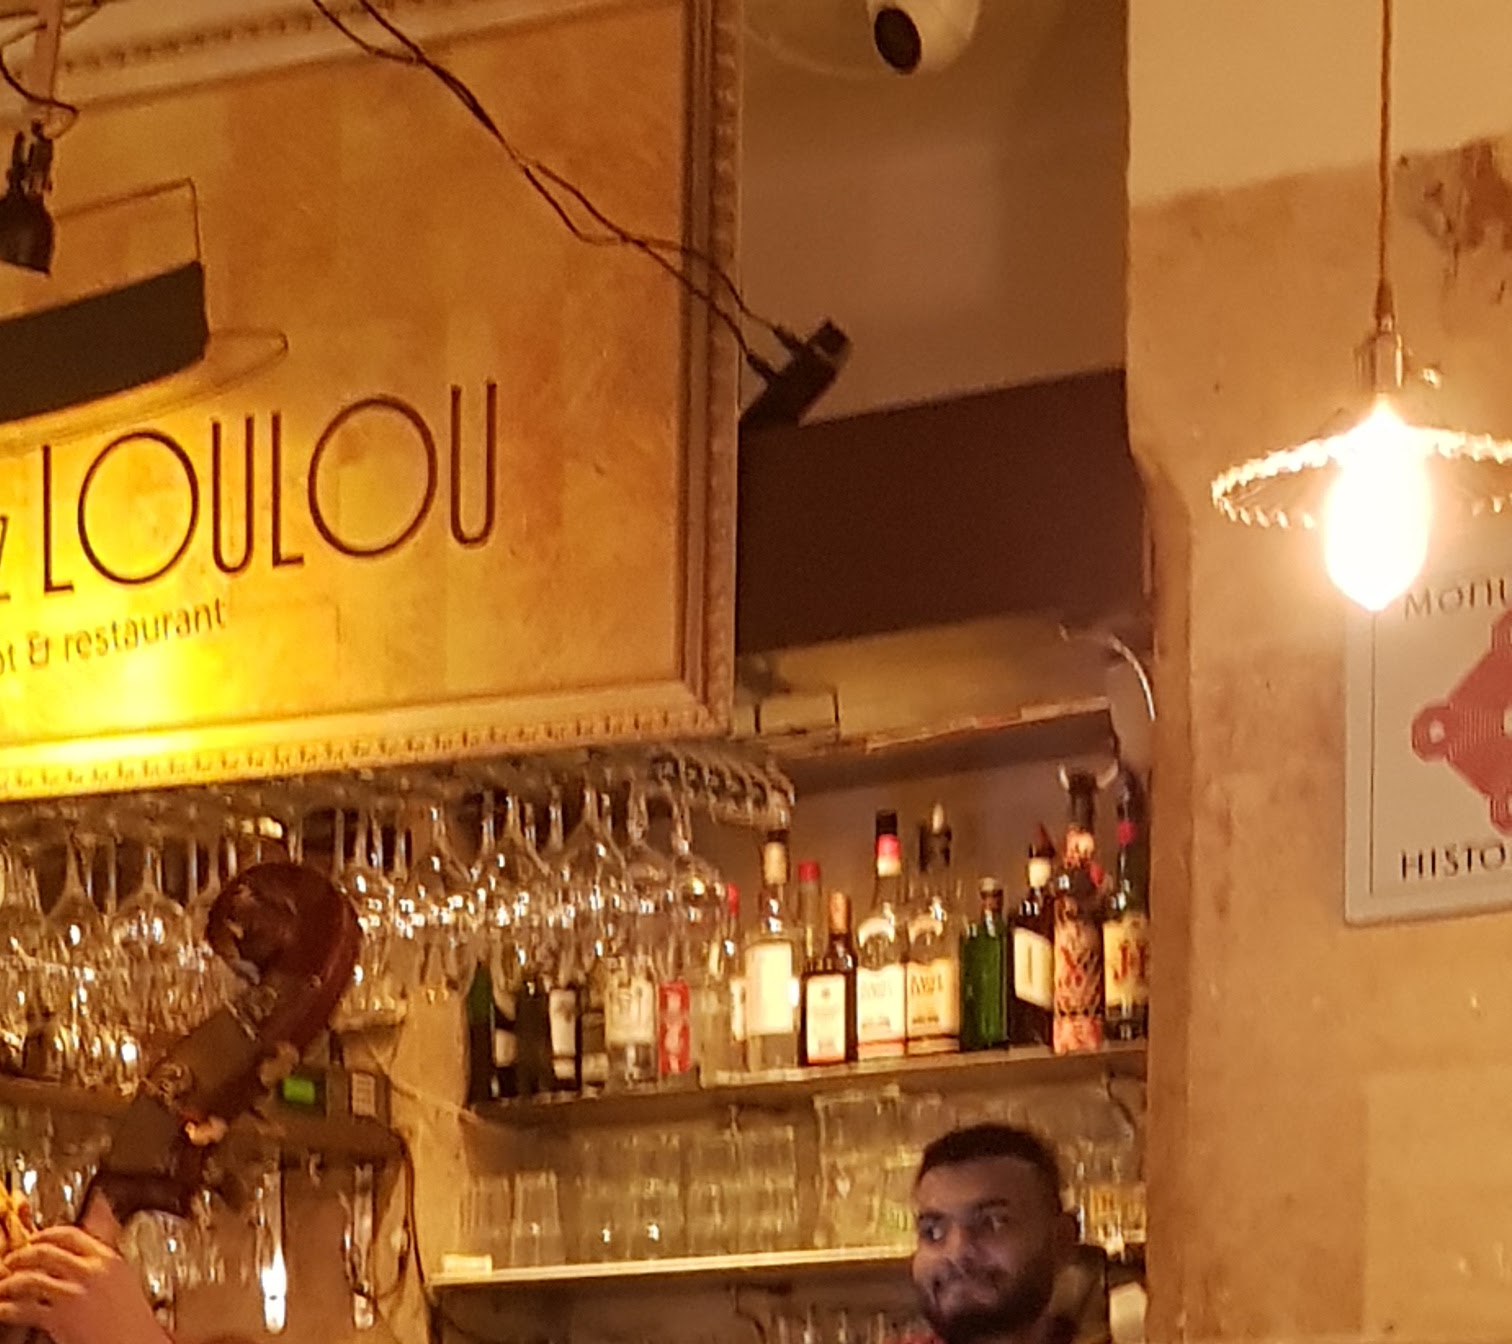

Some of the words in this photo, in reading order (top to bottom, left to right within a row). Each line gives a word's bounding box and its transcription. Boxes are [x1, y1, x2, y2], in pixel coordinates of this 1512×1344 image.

[41, 379, 498, 595] LOULOU
[27, 631, 50, 668] &
[64, 598, 226, 662] restaurant
